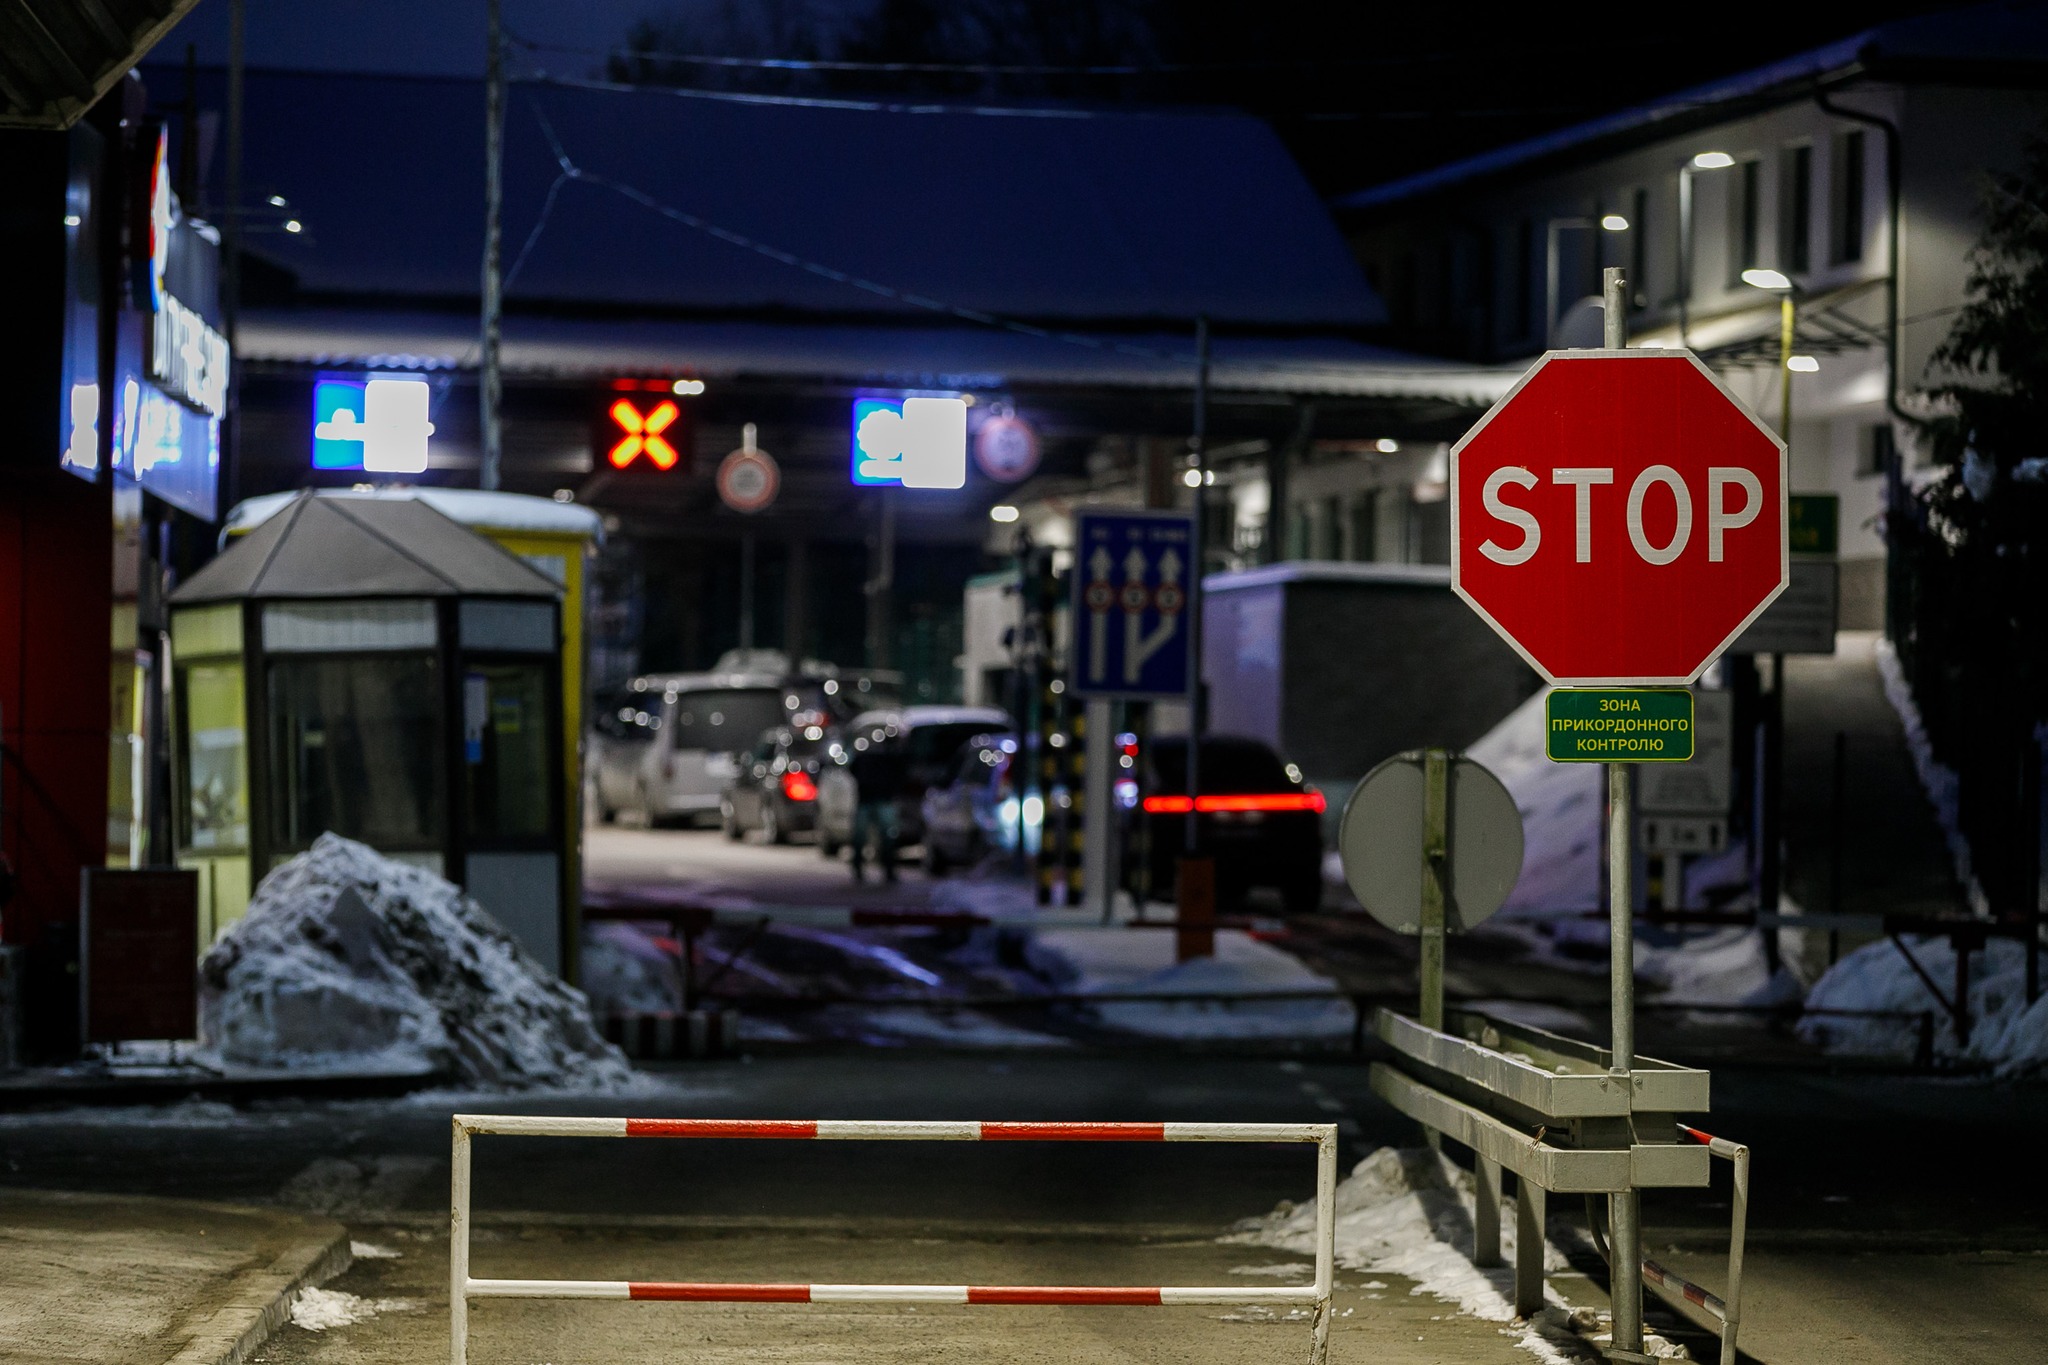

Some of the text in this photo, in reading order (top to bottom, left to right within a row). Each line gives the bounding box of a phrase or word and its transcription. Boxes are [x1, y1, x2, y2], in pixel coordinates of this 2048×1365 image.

[1478, 464, 1764, 566] STOP
[1599, 699, 1641, 712] ЗОНА
[1552, 719, 1689, 733] ПРИКОРДОННОГО
[1577, 738, 1664, 751] КОНТРОЛЮ
